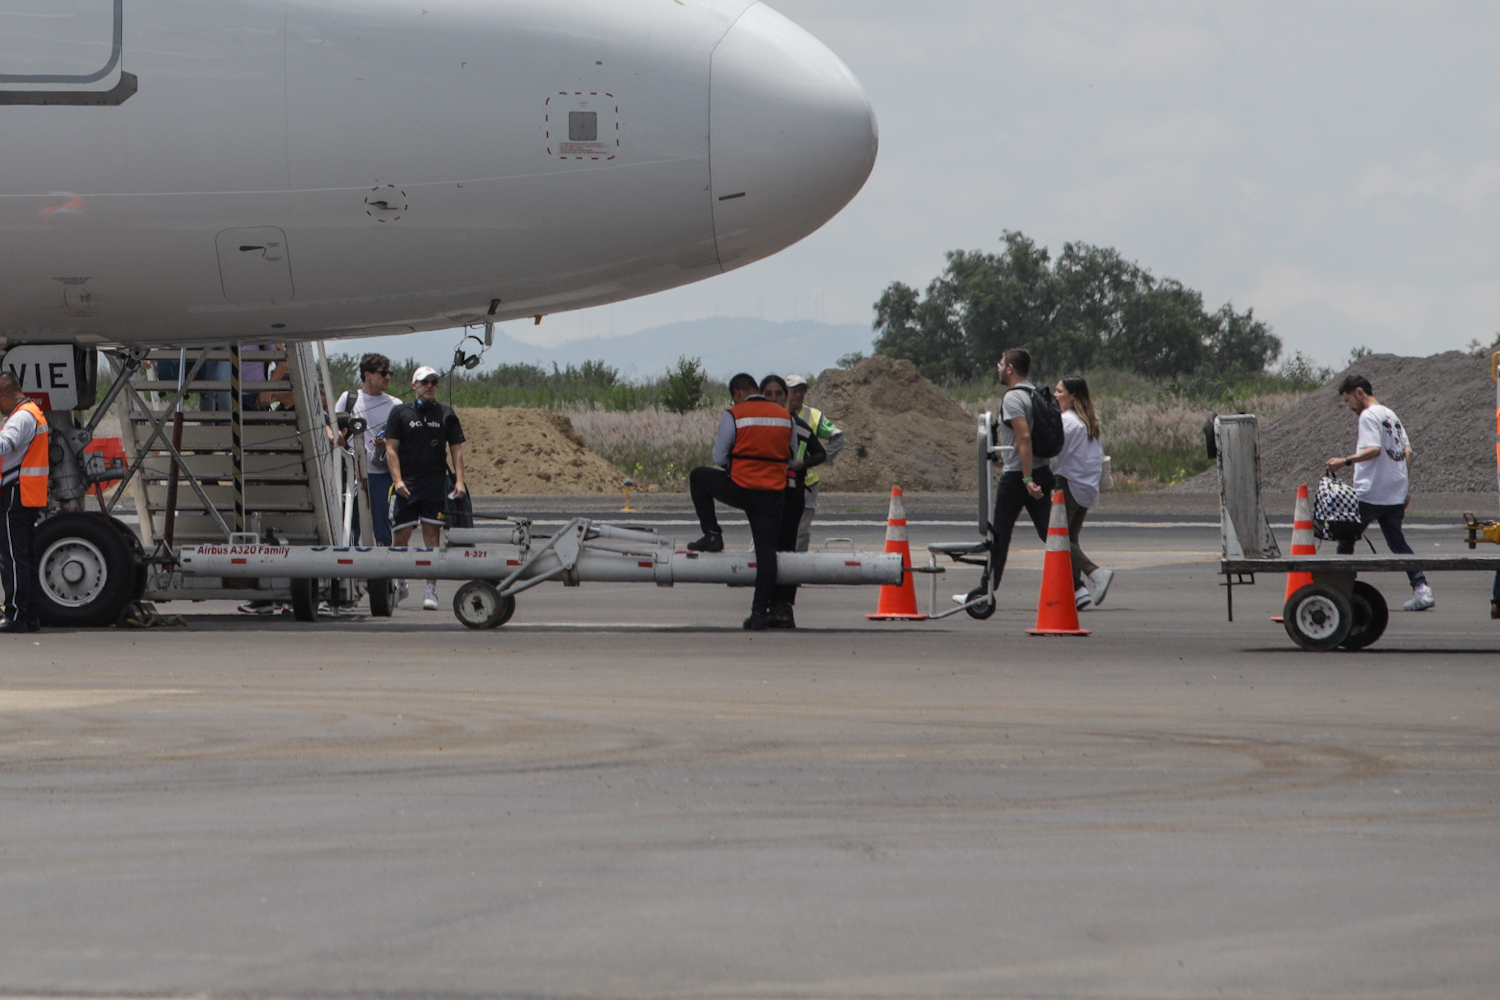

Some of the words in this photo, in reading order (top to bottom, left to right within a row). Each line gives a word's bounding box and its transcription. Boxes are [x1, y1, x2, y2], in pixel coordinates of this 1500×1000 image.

[9, 363, 69, 388] VIE
[197, 546, 228, 555] Airbus
[229, 546, 257, 555] A320
[258, 546, 290, 558] Family
